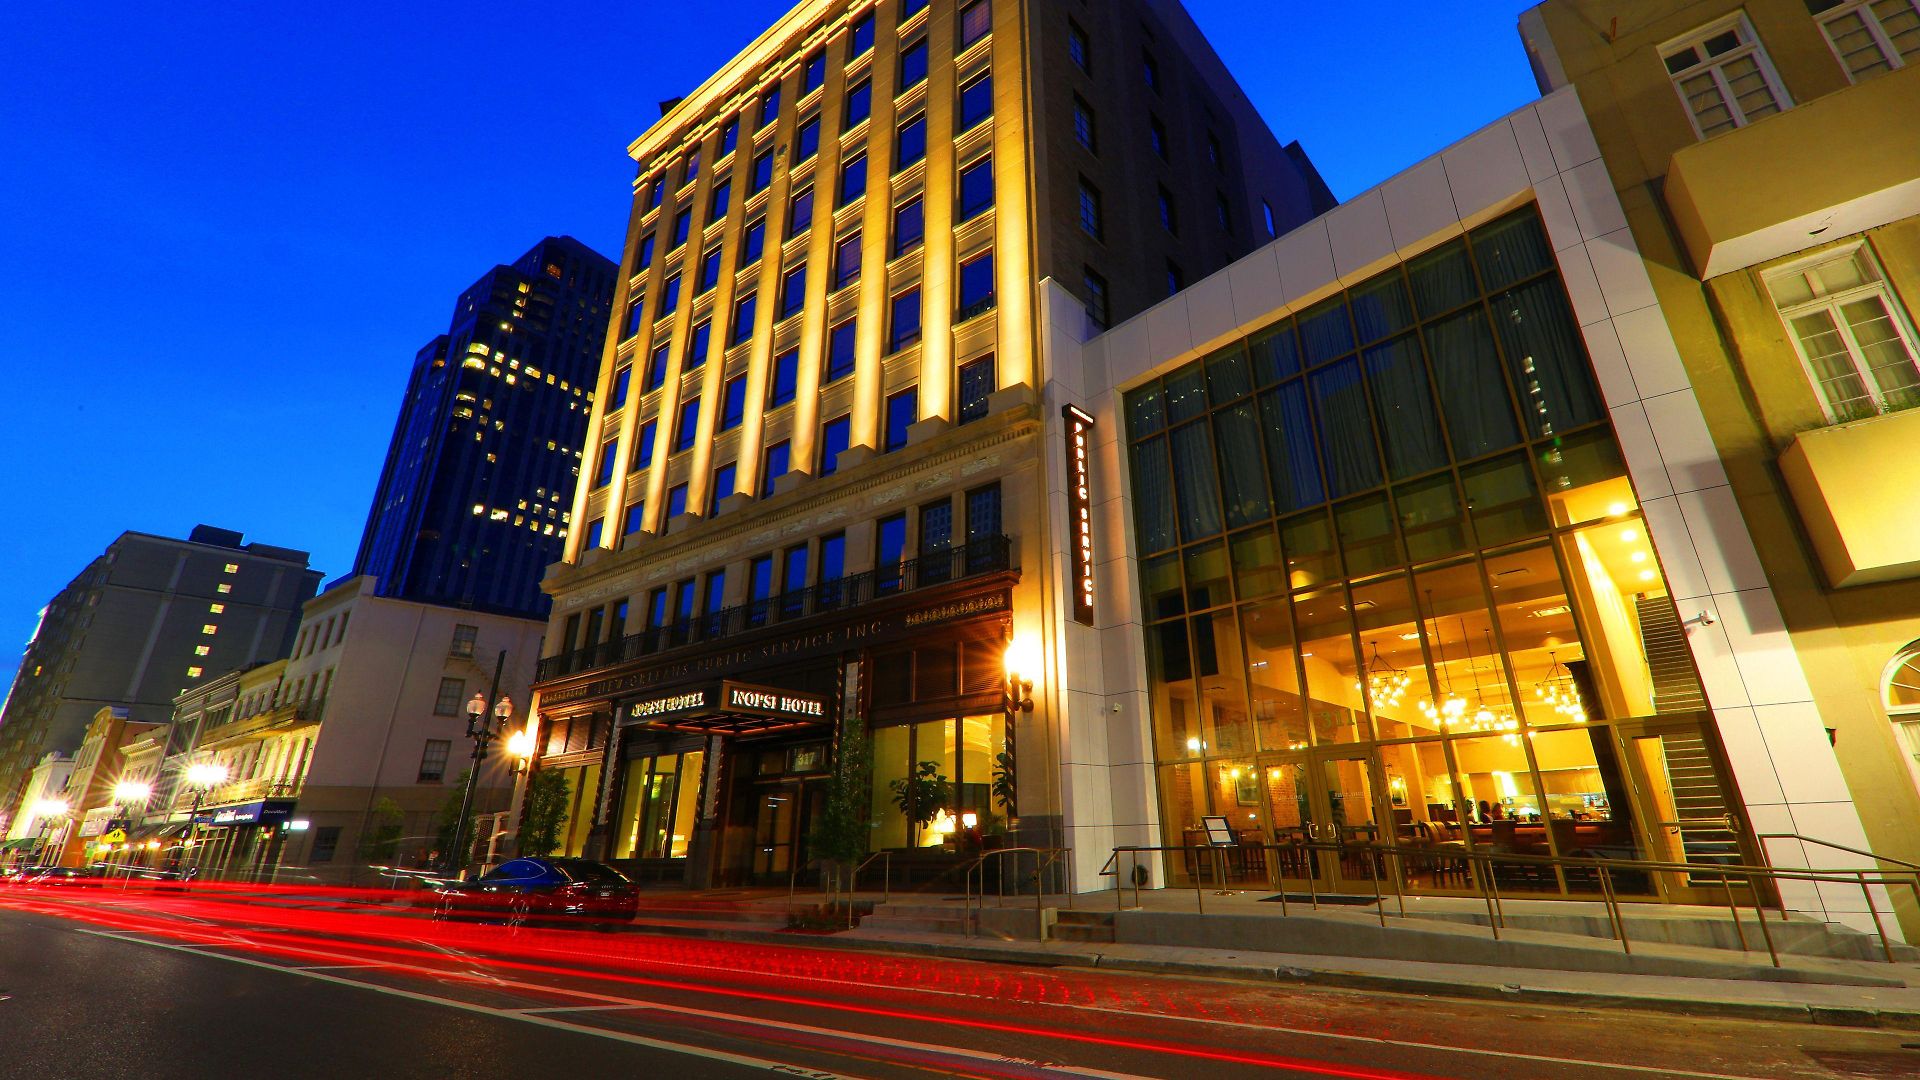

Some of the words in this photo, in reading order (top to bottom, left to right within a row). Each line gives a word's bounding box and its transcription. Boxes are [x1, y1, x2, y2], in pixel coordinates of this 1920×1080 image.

[1073, 422, 1088, 500] PUBLIC
[1080, 508, 1093, 606] SERVICE
[732, 689, 777, 710] NOPSI
[780, 697, 824, 716] HOTEL
